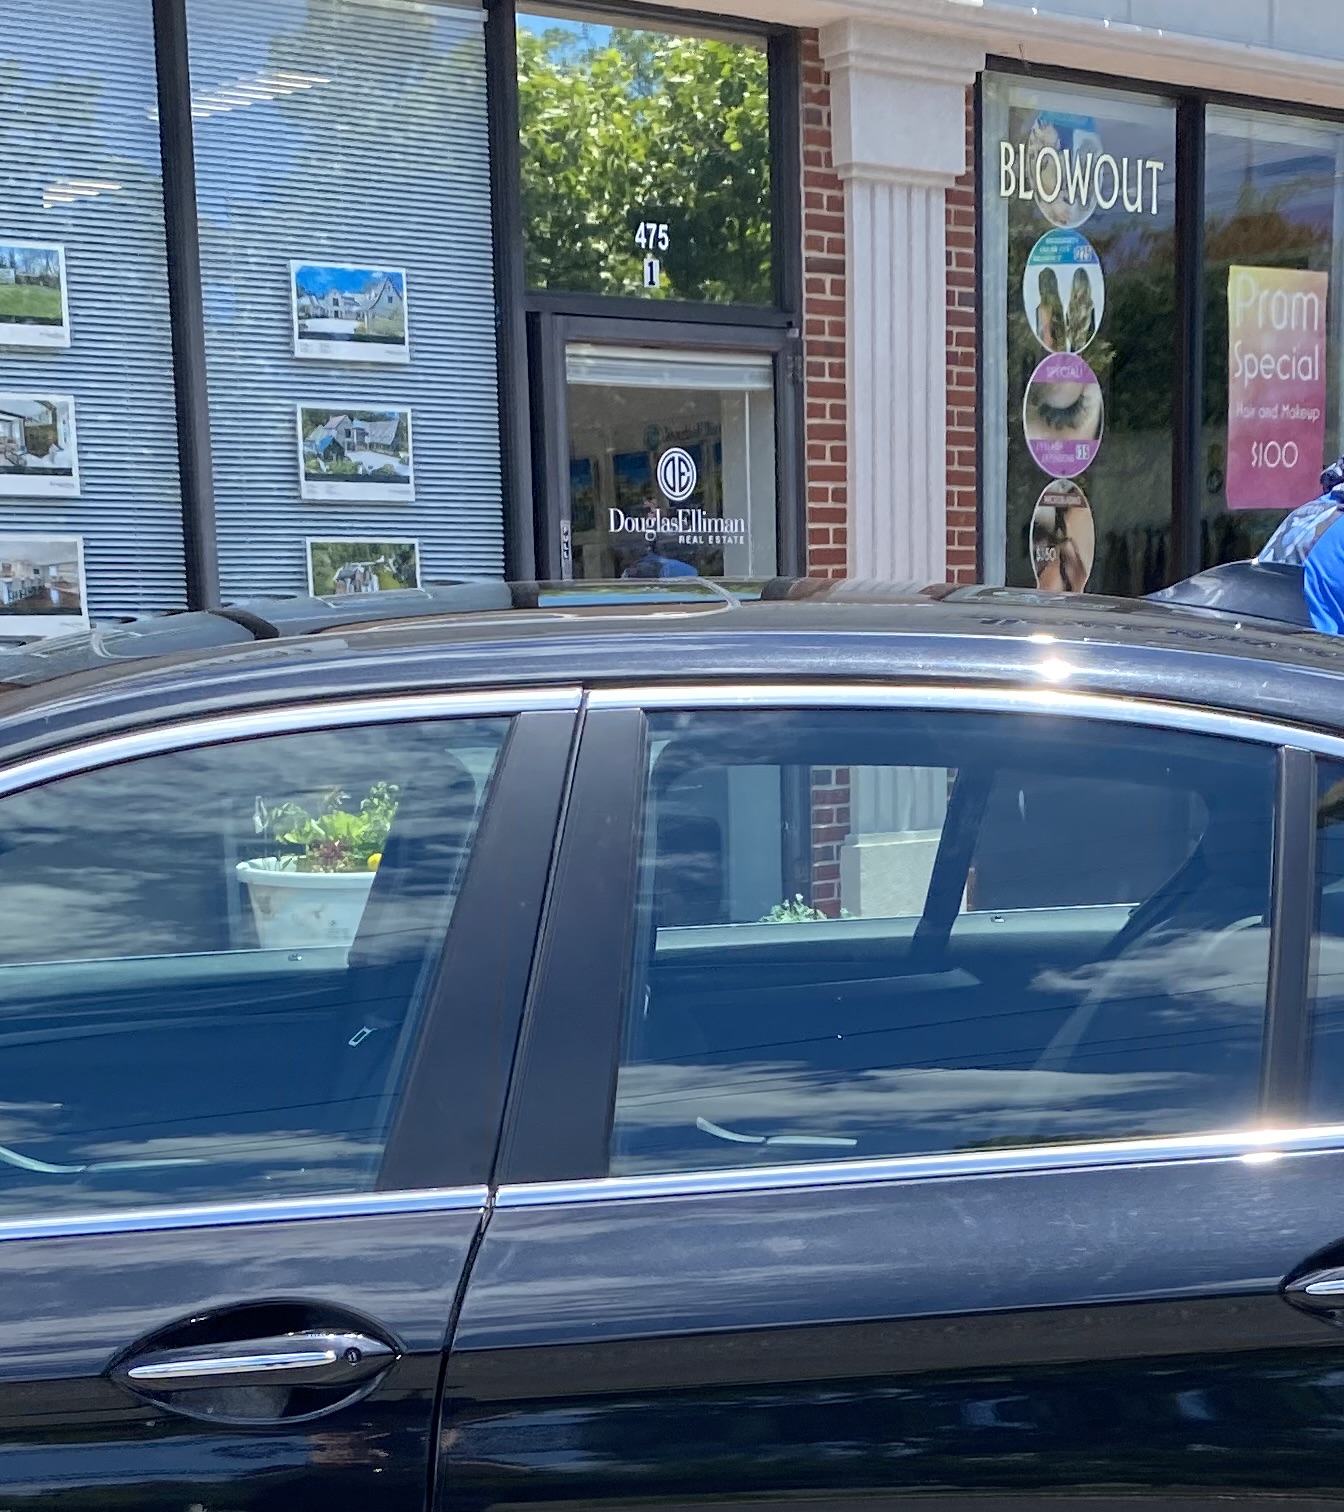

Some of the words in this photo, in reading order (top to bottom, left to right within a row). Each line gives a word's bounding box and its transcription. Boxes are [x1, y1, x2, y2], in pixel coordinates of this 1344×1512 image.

[1000, 142, 1164, 215] BLOWOUT
[635, 221, 669, 251] 475
[647, 261, 656, 286] 1
[1235, 271, 1320, 331] Prom
[1234, 340, 1320, 388] Special
[1258, 404, 1279, 419] and
[1281, 403, 1321, 423] Makeup
[1251, 441, 1299, 468] $100
[608, 508, 745, 541] DouglasElliman
[679, 535, 704, 545] REAL
[709, 535, 745, 545] ESTATE
